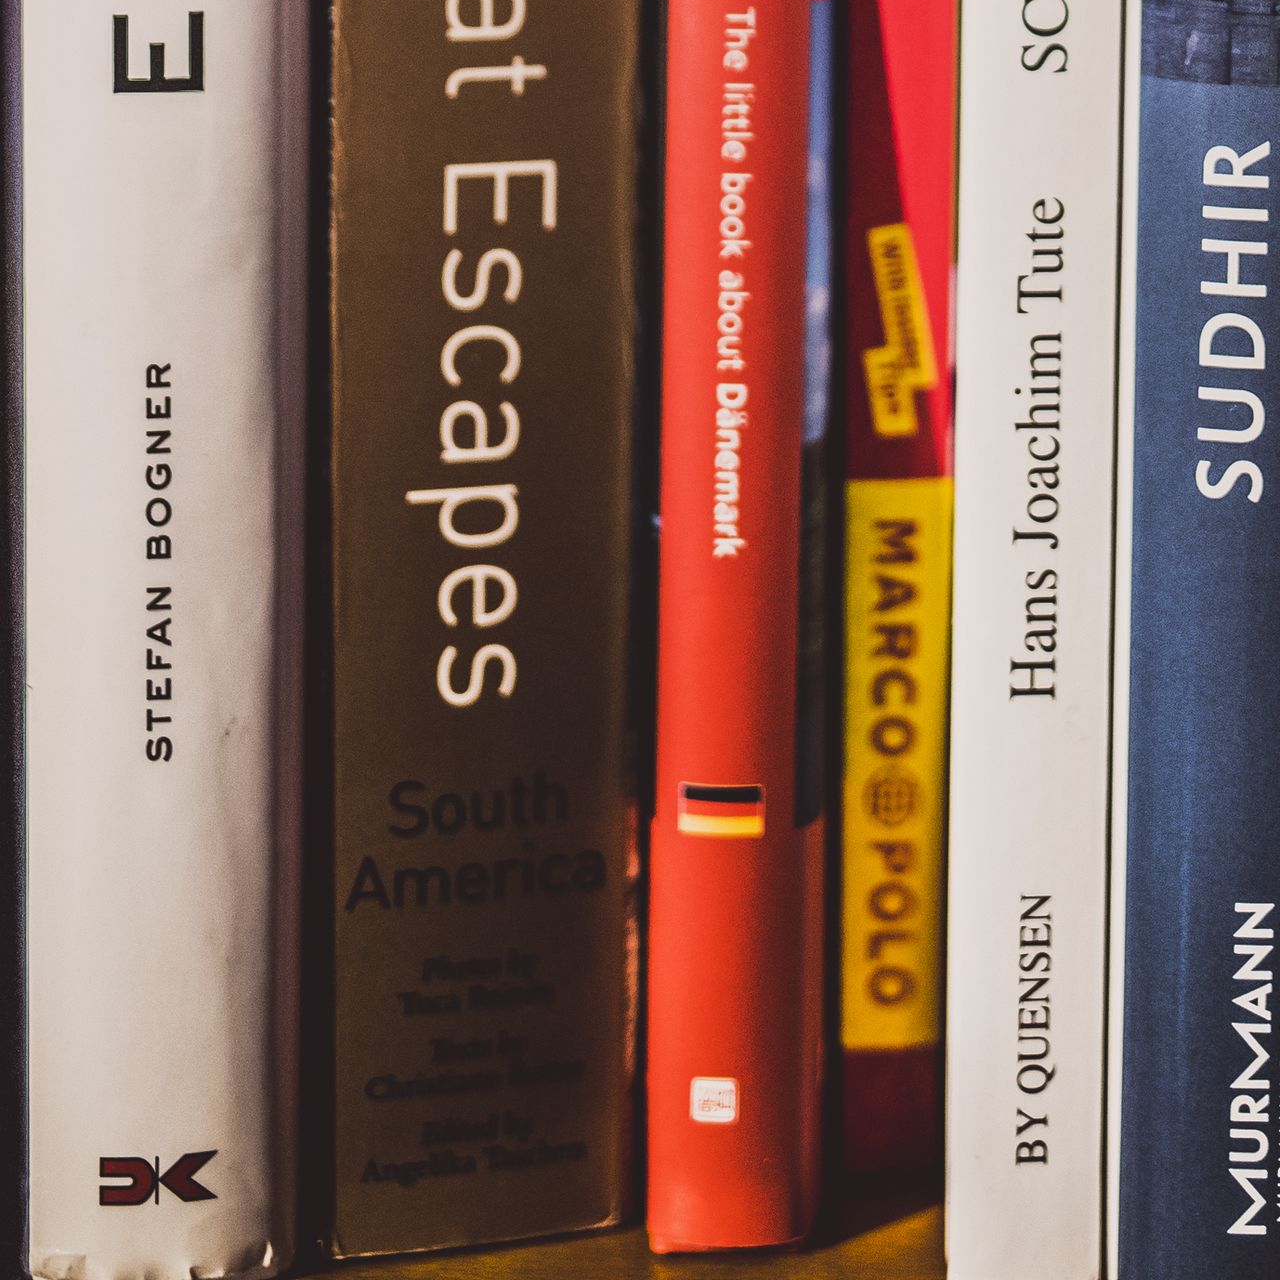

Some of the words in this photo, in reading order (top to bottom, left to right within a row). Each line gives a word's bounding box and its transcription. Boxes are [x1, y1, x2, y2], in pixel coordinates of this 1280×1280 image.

[721, 6, 757, 70] The
[720, 83, 755, 161] little
[718, 173, 754, 258] book
[1016, 198, 1065, 314] Tute
[716, 270, 750, 371] about
[1195, 140, 1271, 503] SUDHIR
[145, 361, 173, 561] BOGNER
[405, 159, 557, 707] Escapes
[712, 383, 750, 558] Dänemark
[1012, 333, 1062, 550] Joachim
[145, 585, 173, 764] STEFAN
[869, 518, 921, 756] MARCO
[1009, 569, 1058, 699] Hans
[345, 843, 607, 912] America
[388, 770, 569, 838] South
[866, 840, 919, 1007] POLO
[1016, 895, 1057, 1095] QUENSEN
[1015, 1108, 1049, 1165] BY
[1226, 901, 1275, 1236] MURMANN
